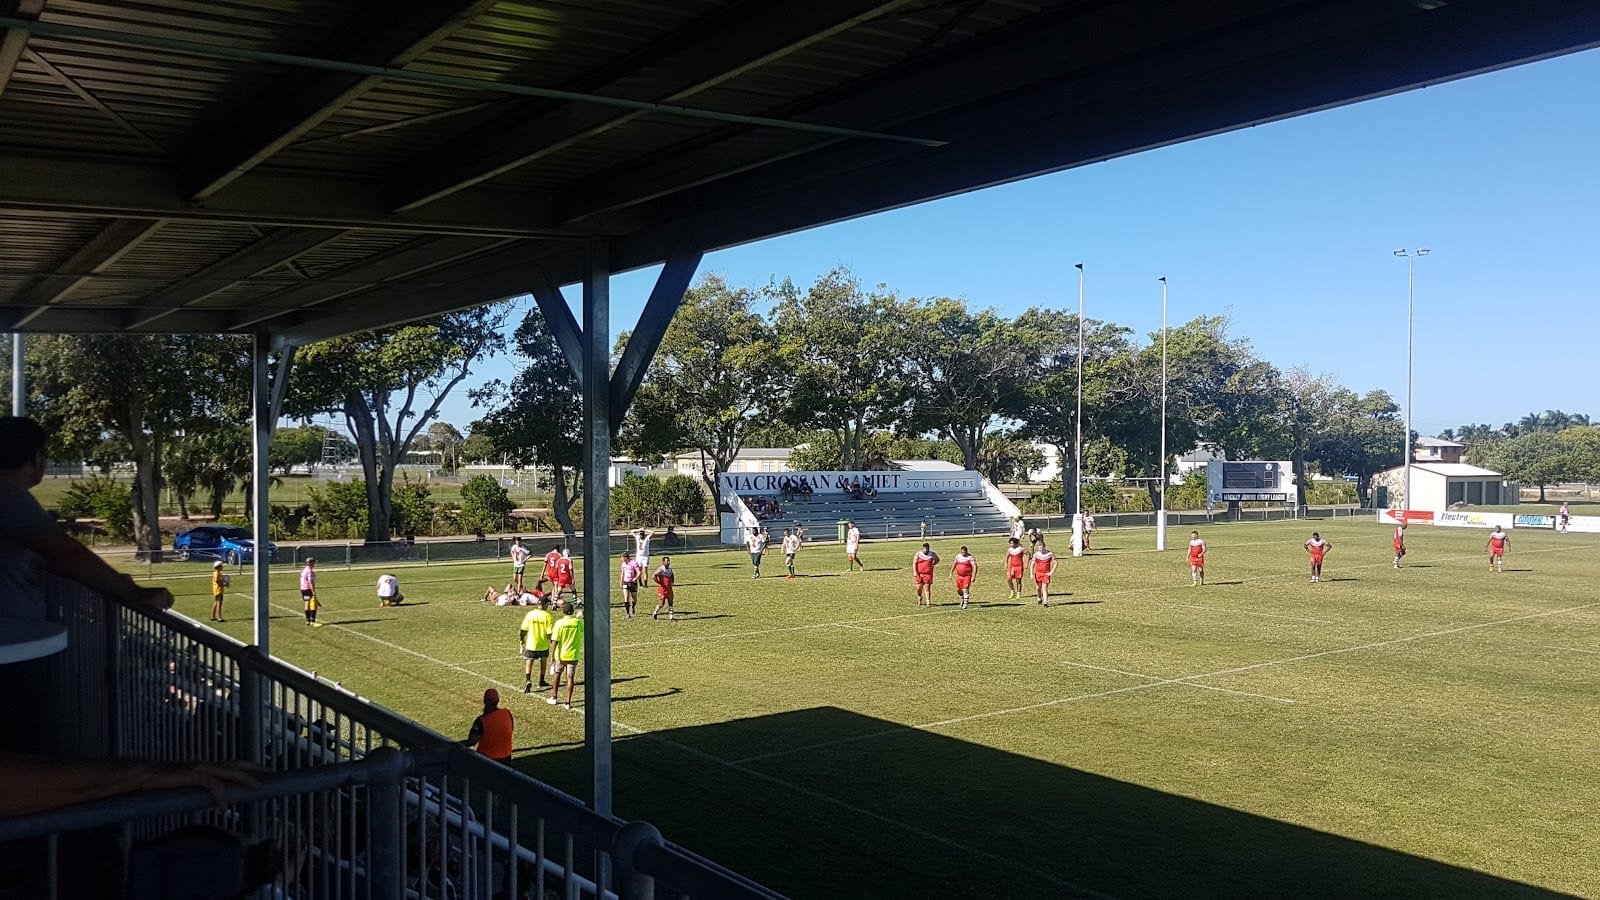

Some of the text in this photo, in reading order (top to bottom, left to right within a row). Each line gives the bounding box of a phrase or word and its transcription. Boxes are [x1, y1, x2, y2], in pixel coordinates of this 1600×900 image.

[835, 475, 847, 490] &
[853, 474, 901, 490] AMIET
[906, 480, 974, 489] SOLICITORS
[550, 557, 555, 567] 5
[560, 563, 566, 573] 2
